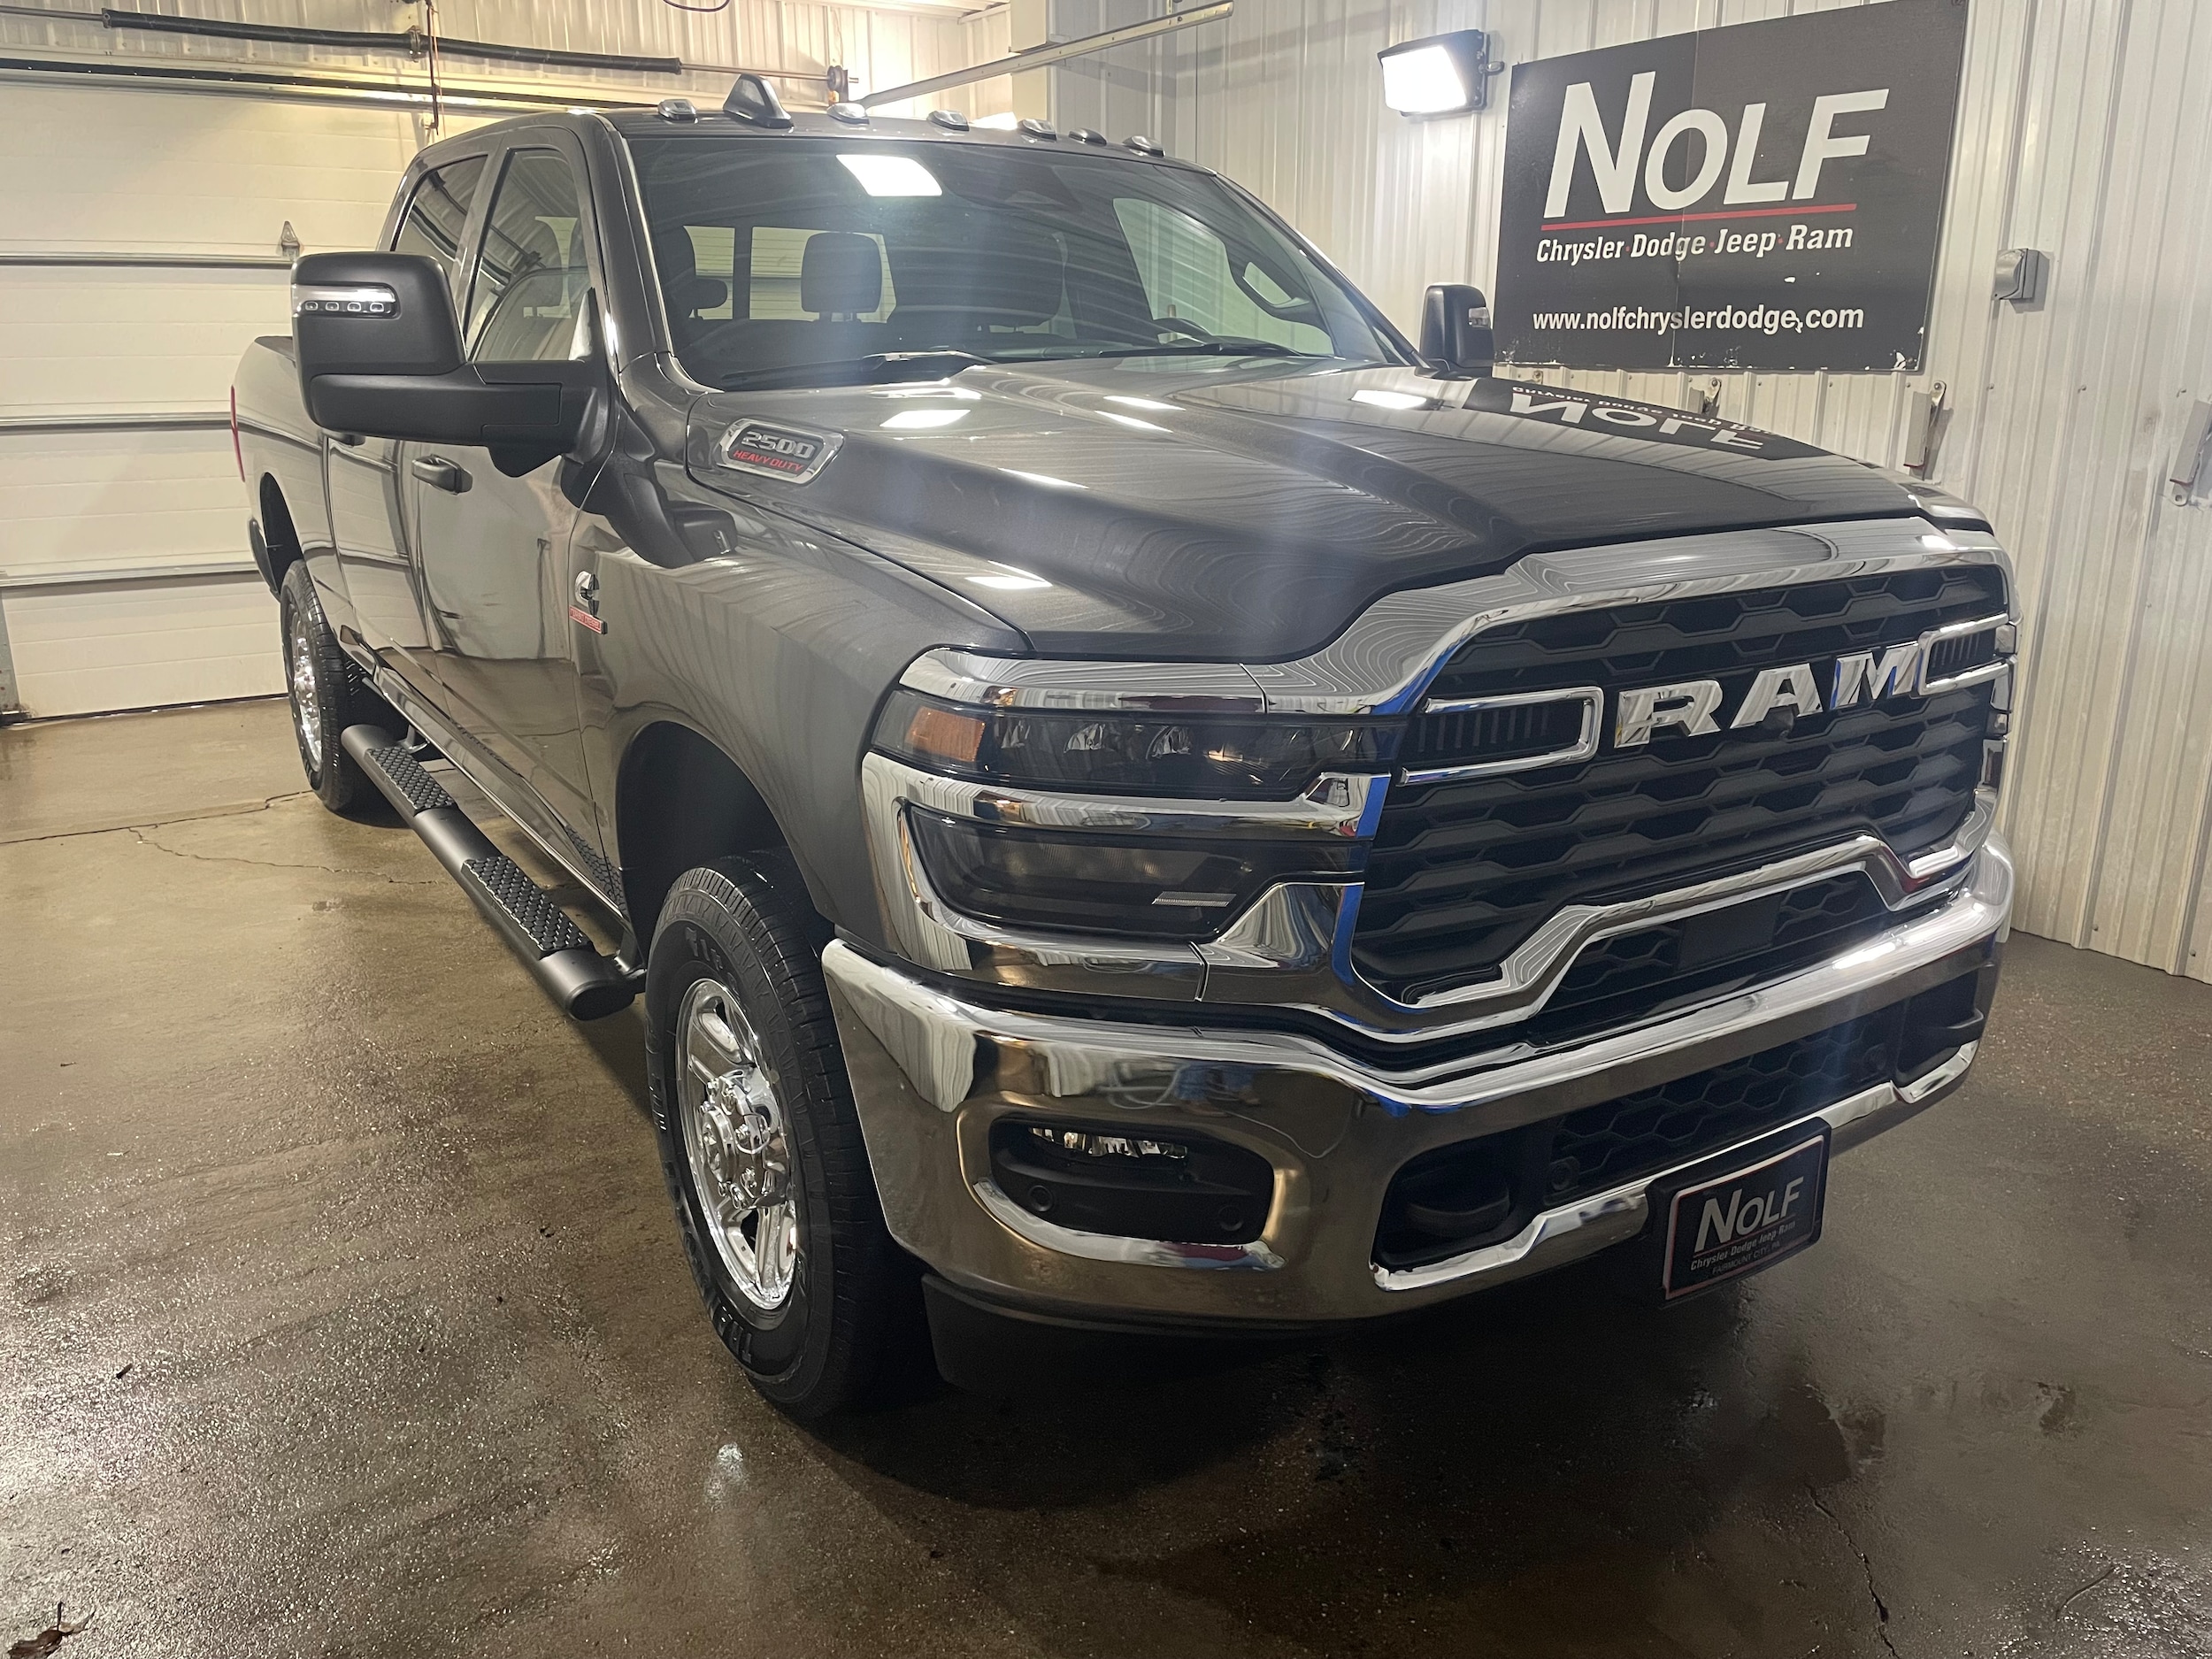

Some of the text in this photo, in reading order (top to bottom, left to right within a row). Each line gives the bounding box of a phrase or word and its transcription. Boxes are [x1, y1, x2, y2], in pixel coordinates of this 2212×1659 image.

[1543, 71, 1889, 219] NOLF
[1536, 224, 1853, 265] Chrysler Dodge Jeep Ram
[1532, 304, 1863, 335] www.nolfchryslerdodge.com
[733, 449, 804, 472] HEAVY DUTY
[741, 431, 816, 459] 2500
[1614, 641, 1919, 749] RAM
[1694, 1176, 1804, 1253] NOLF
[1690, 1250, 1728, 1271] Chrysler
[1731, 1239, 1757, 1256] Dodge
[1778, 1219, 1795, 1235] Ram
